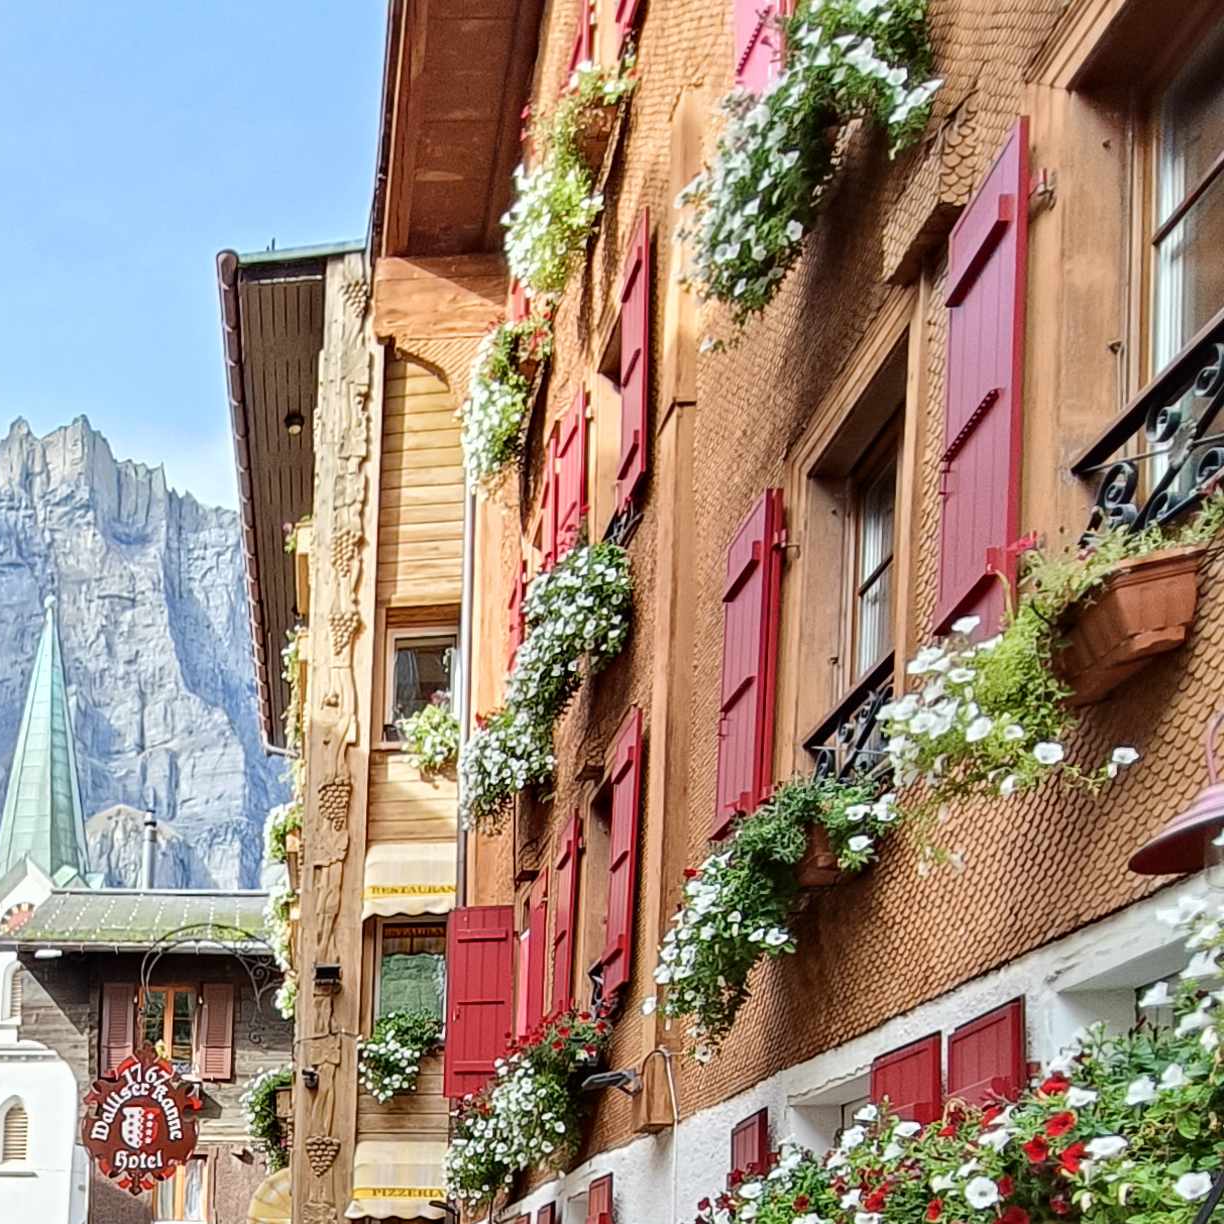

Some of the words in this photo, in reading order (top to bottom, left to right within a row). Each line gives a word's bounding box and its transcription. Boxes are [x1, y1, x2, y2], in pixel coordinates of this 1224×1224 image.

[371, 885, 456, 894] RESTAURAN
[121, 1063, 170, 1086] 1767
[91, 1083, 150, 1140] Walliser
[152, 1085, 182, 1140] Kanne
[115, 1150, 163, 1173] Hotel
[372, 1188, 445, 1197] PIZZERIA
